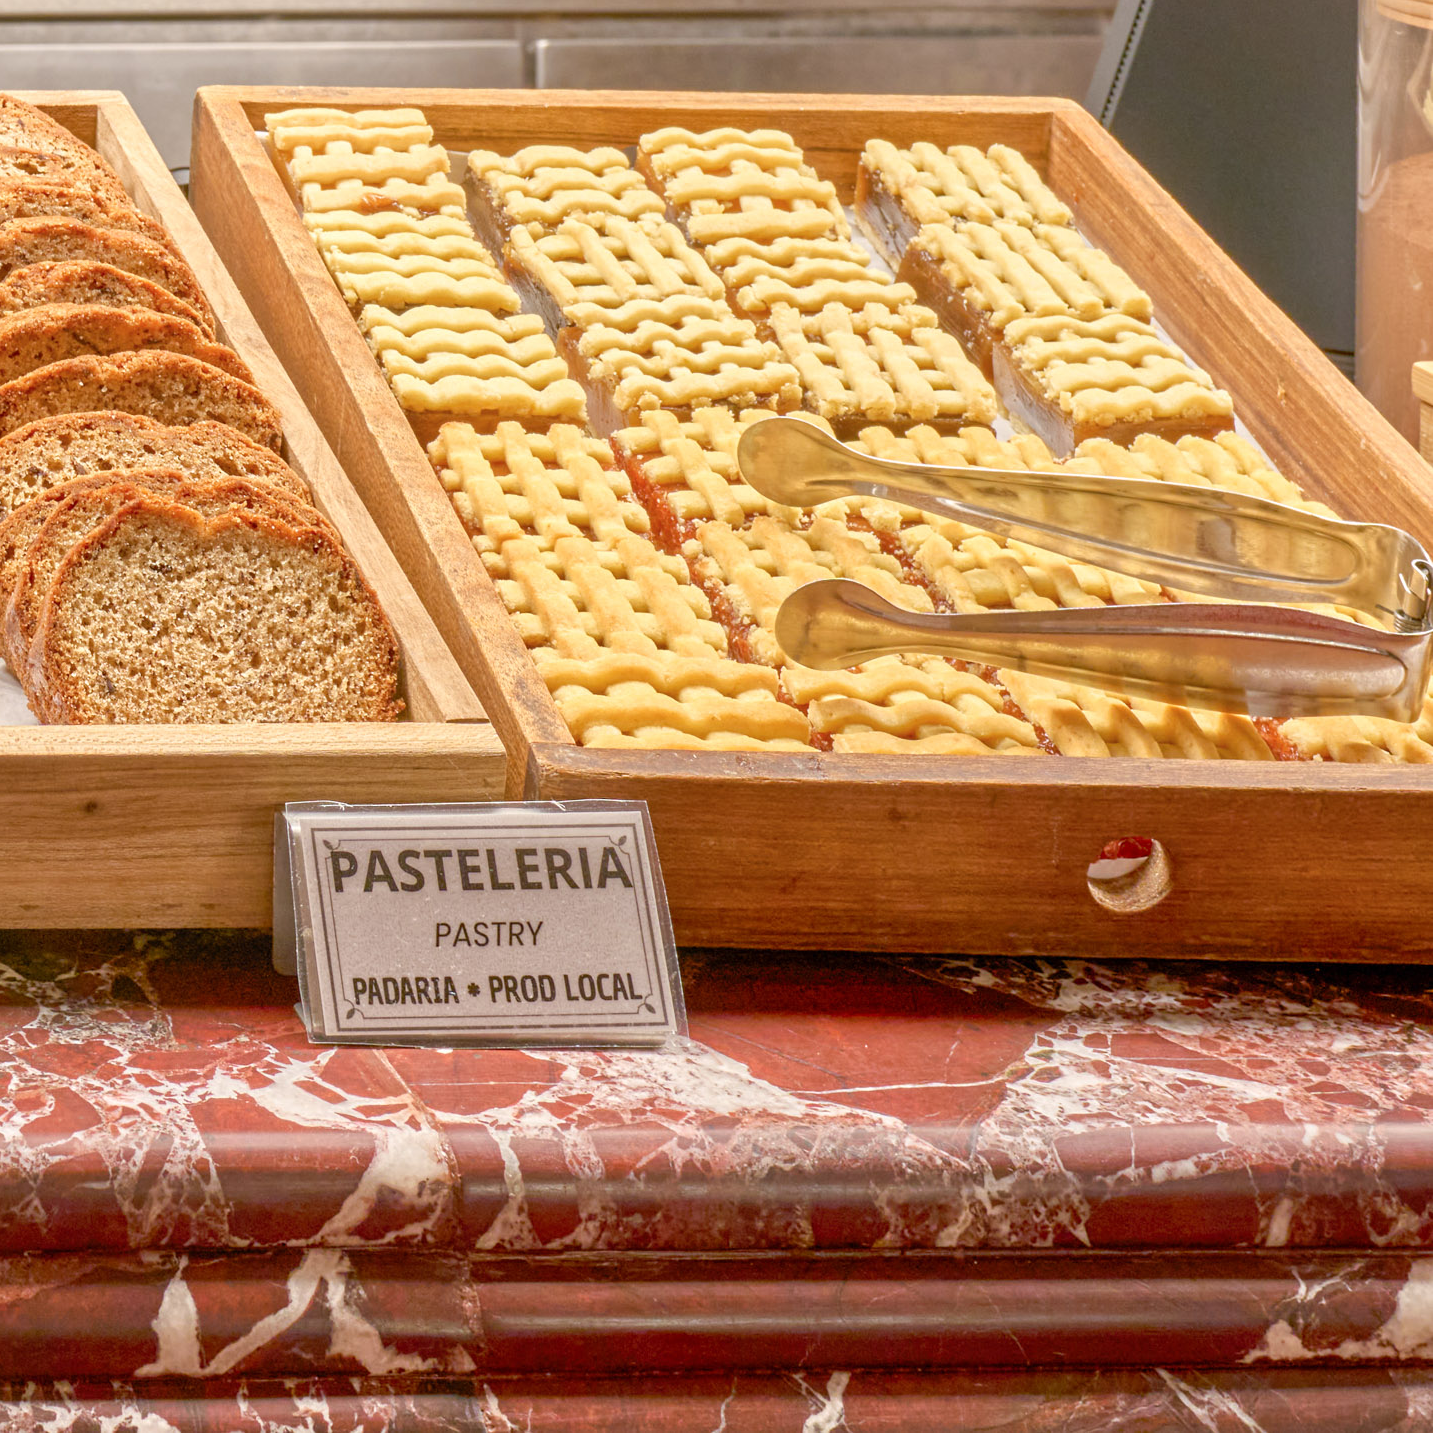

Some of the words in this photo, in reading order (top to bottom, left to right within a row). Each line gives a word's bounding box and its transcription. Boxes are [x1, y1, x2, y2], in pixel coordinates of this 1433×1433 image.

[331, 847, 634, 893] PASTELERIA
[435, 921, 544, 948] PASTRY
[352, 976, 460, 1006] PADARIA
[489, 975, 557, 1004] PROD
[563, 972, 644, 1003] LOCAL
